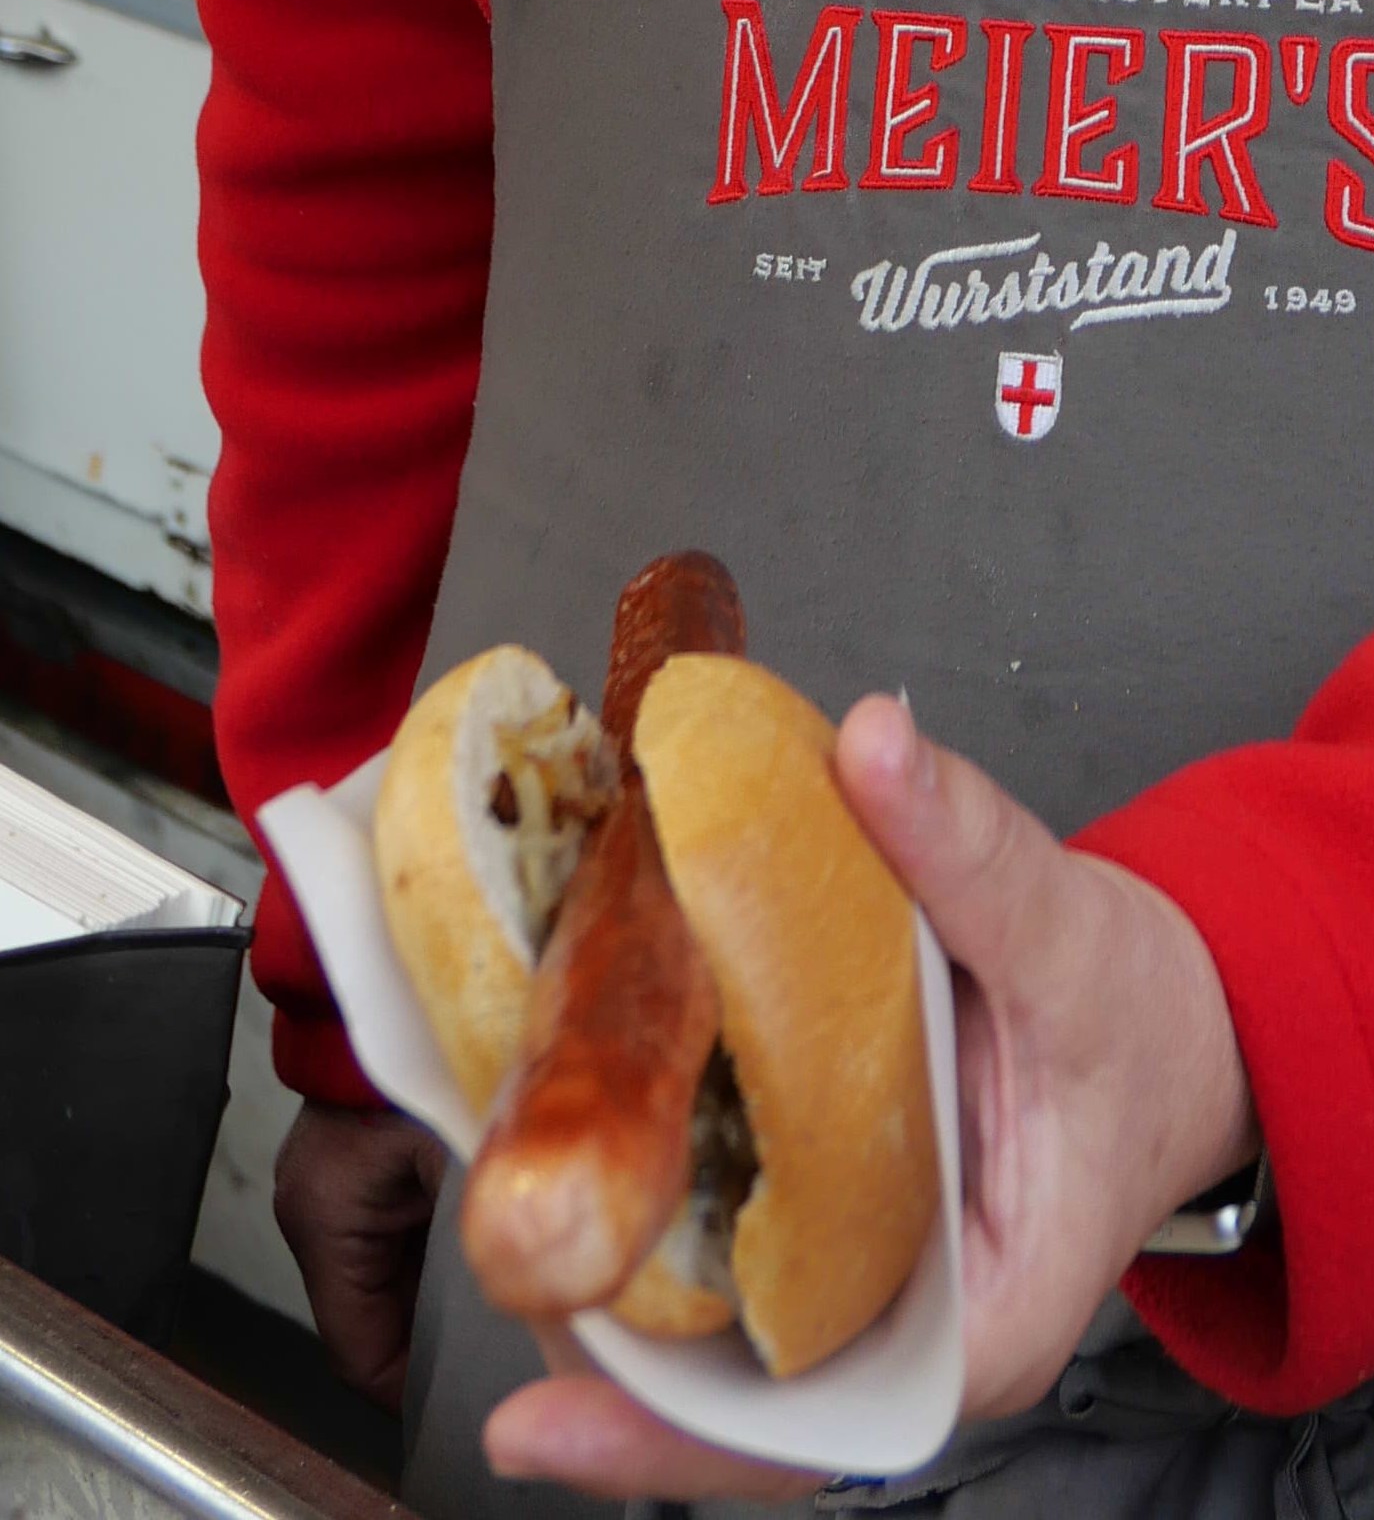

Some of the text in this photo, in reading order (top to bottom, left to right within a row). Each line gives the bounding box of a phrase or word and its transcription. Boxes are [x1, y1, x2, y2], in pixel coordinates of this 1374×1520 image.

[751, 228, 1357, 334] SEIT Wurststand 1949
